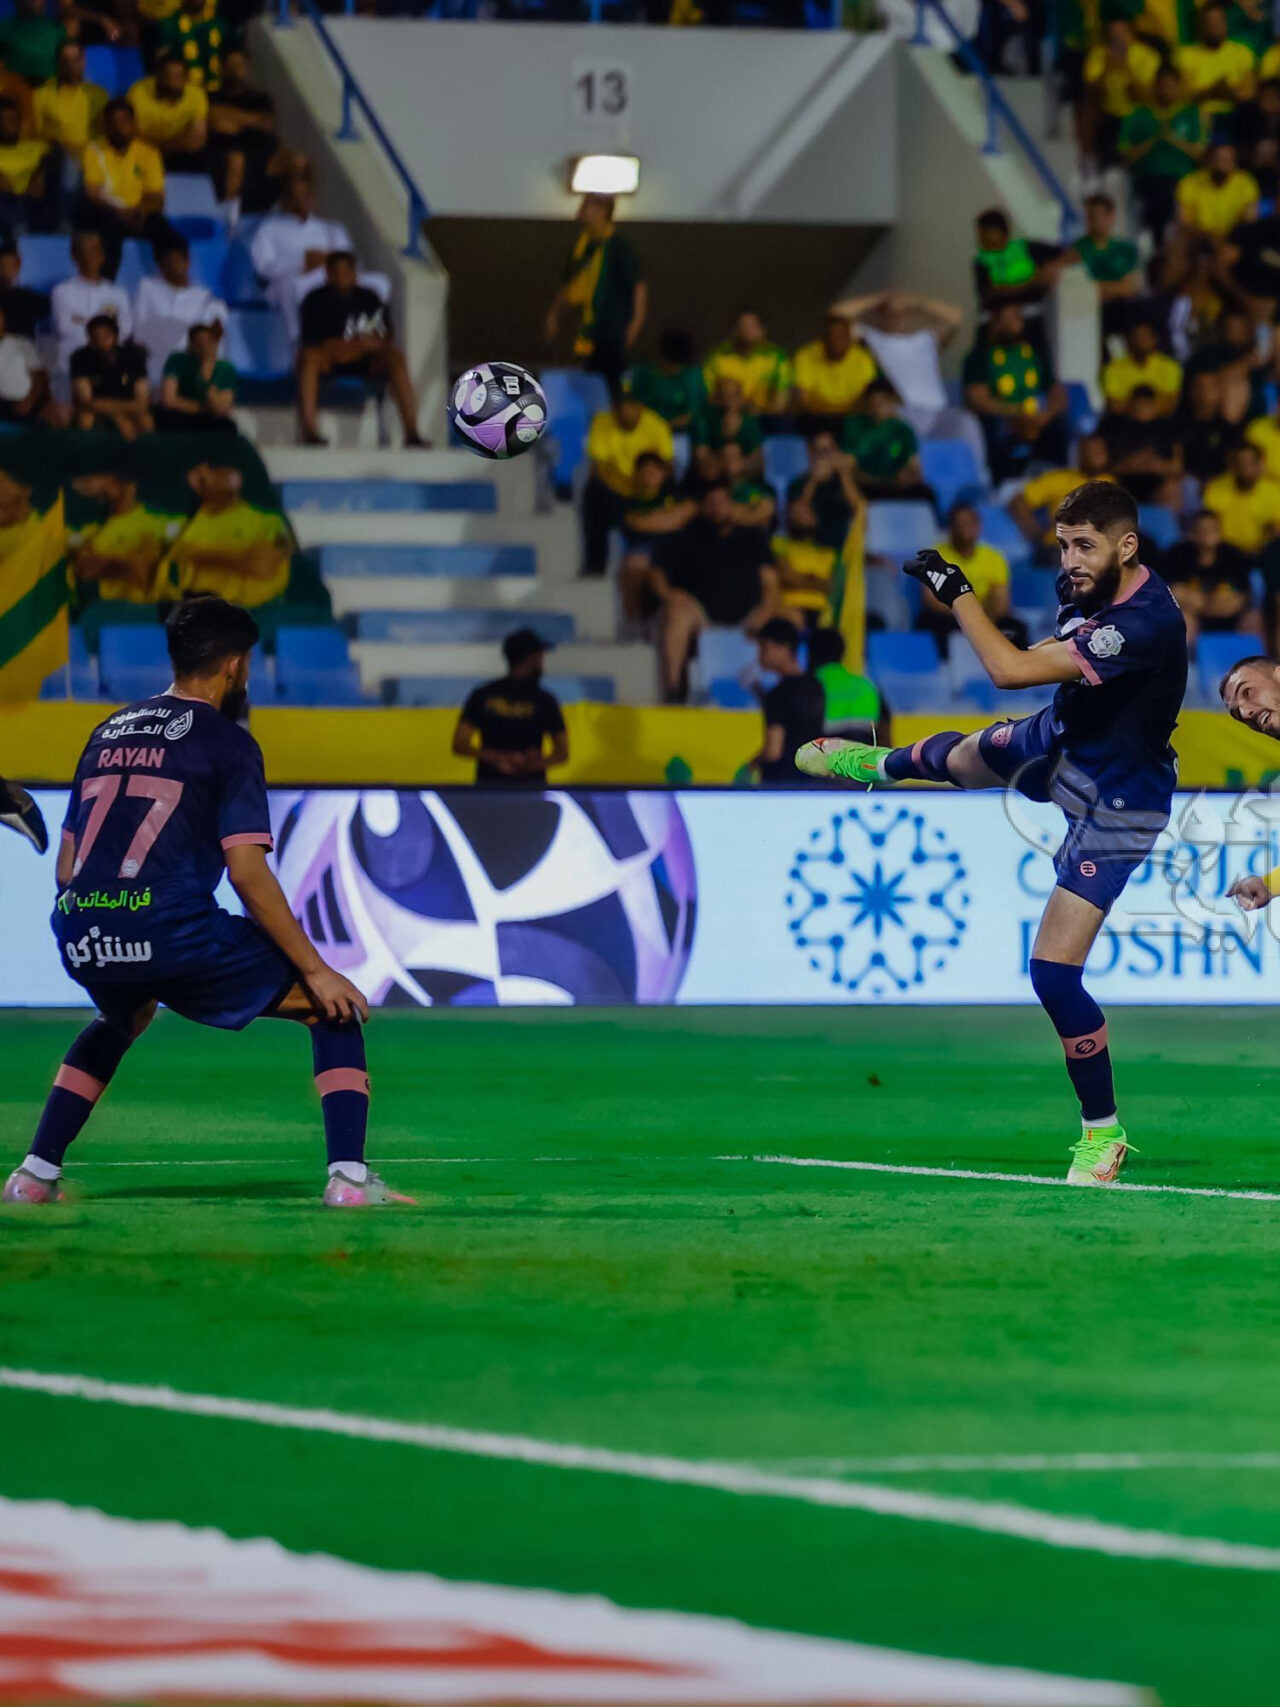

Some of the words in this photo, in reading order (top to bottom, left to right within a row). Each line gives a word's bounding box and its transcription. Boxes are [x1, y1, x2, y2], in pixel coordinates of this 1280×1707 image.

[575, 68, 629, 116] 13
[97, 747, 166, 769] RAYAN
[73, 773, 184, 879] 77
